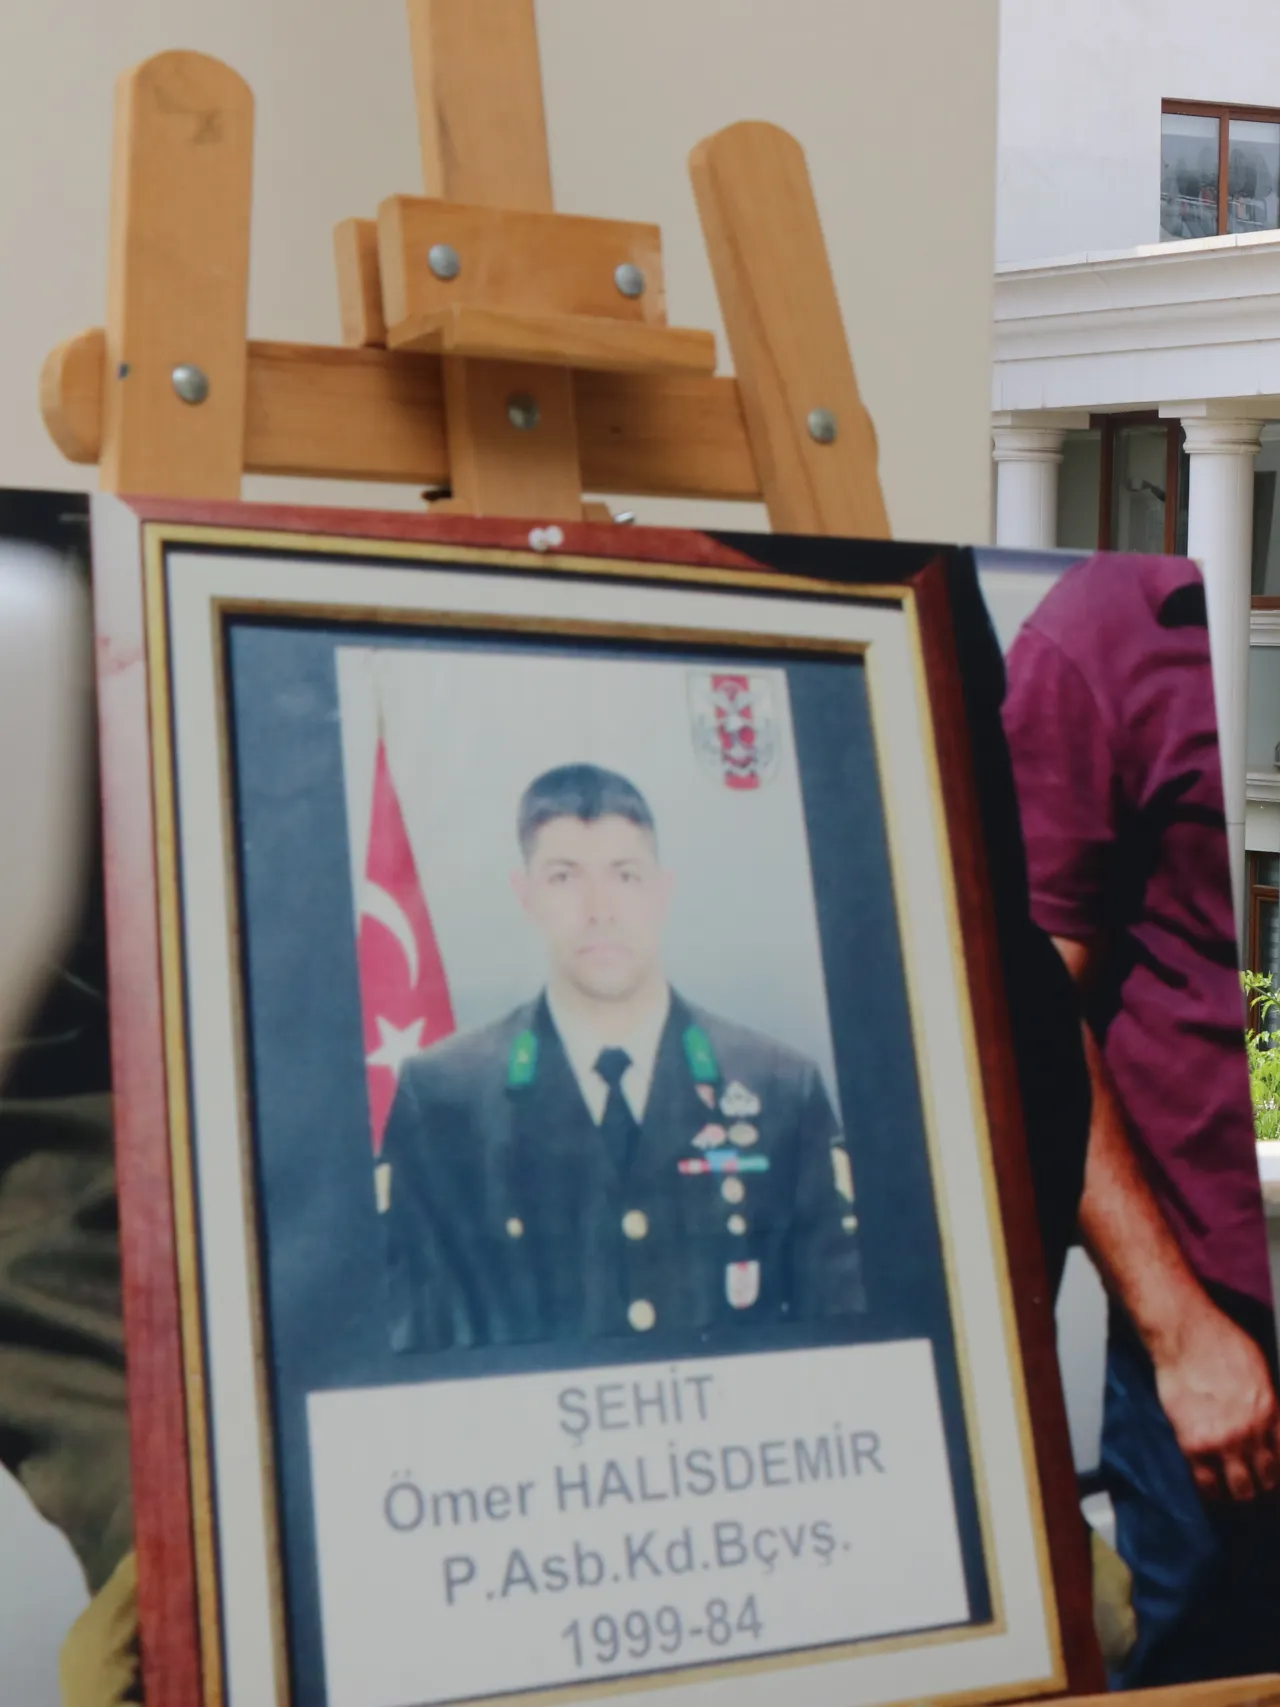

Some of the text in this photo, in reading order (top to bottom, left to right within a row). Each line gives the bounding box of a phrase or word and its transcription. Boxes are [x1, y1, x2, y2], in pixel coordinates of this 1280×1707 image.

[557, 1366, 716, 1447] ŞEHİT
[383, 1422, 887, 1533] Ömer HALİSDEMİR
[560, 1594, 766, 1669] 1999-84
